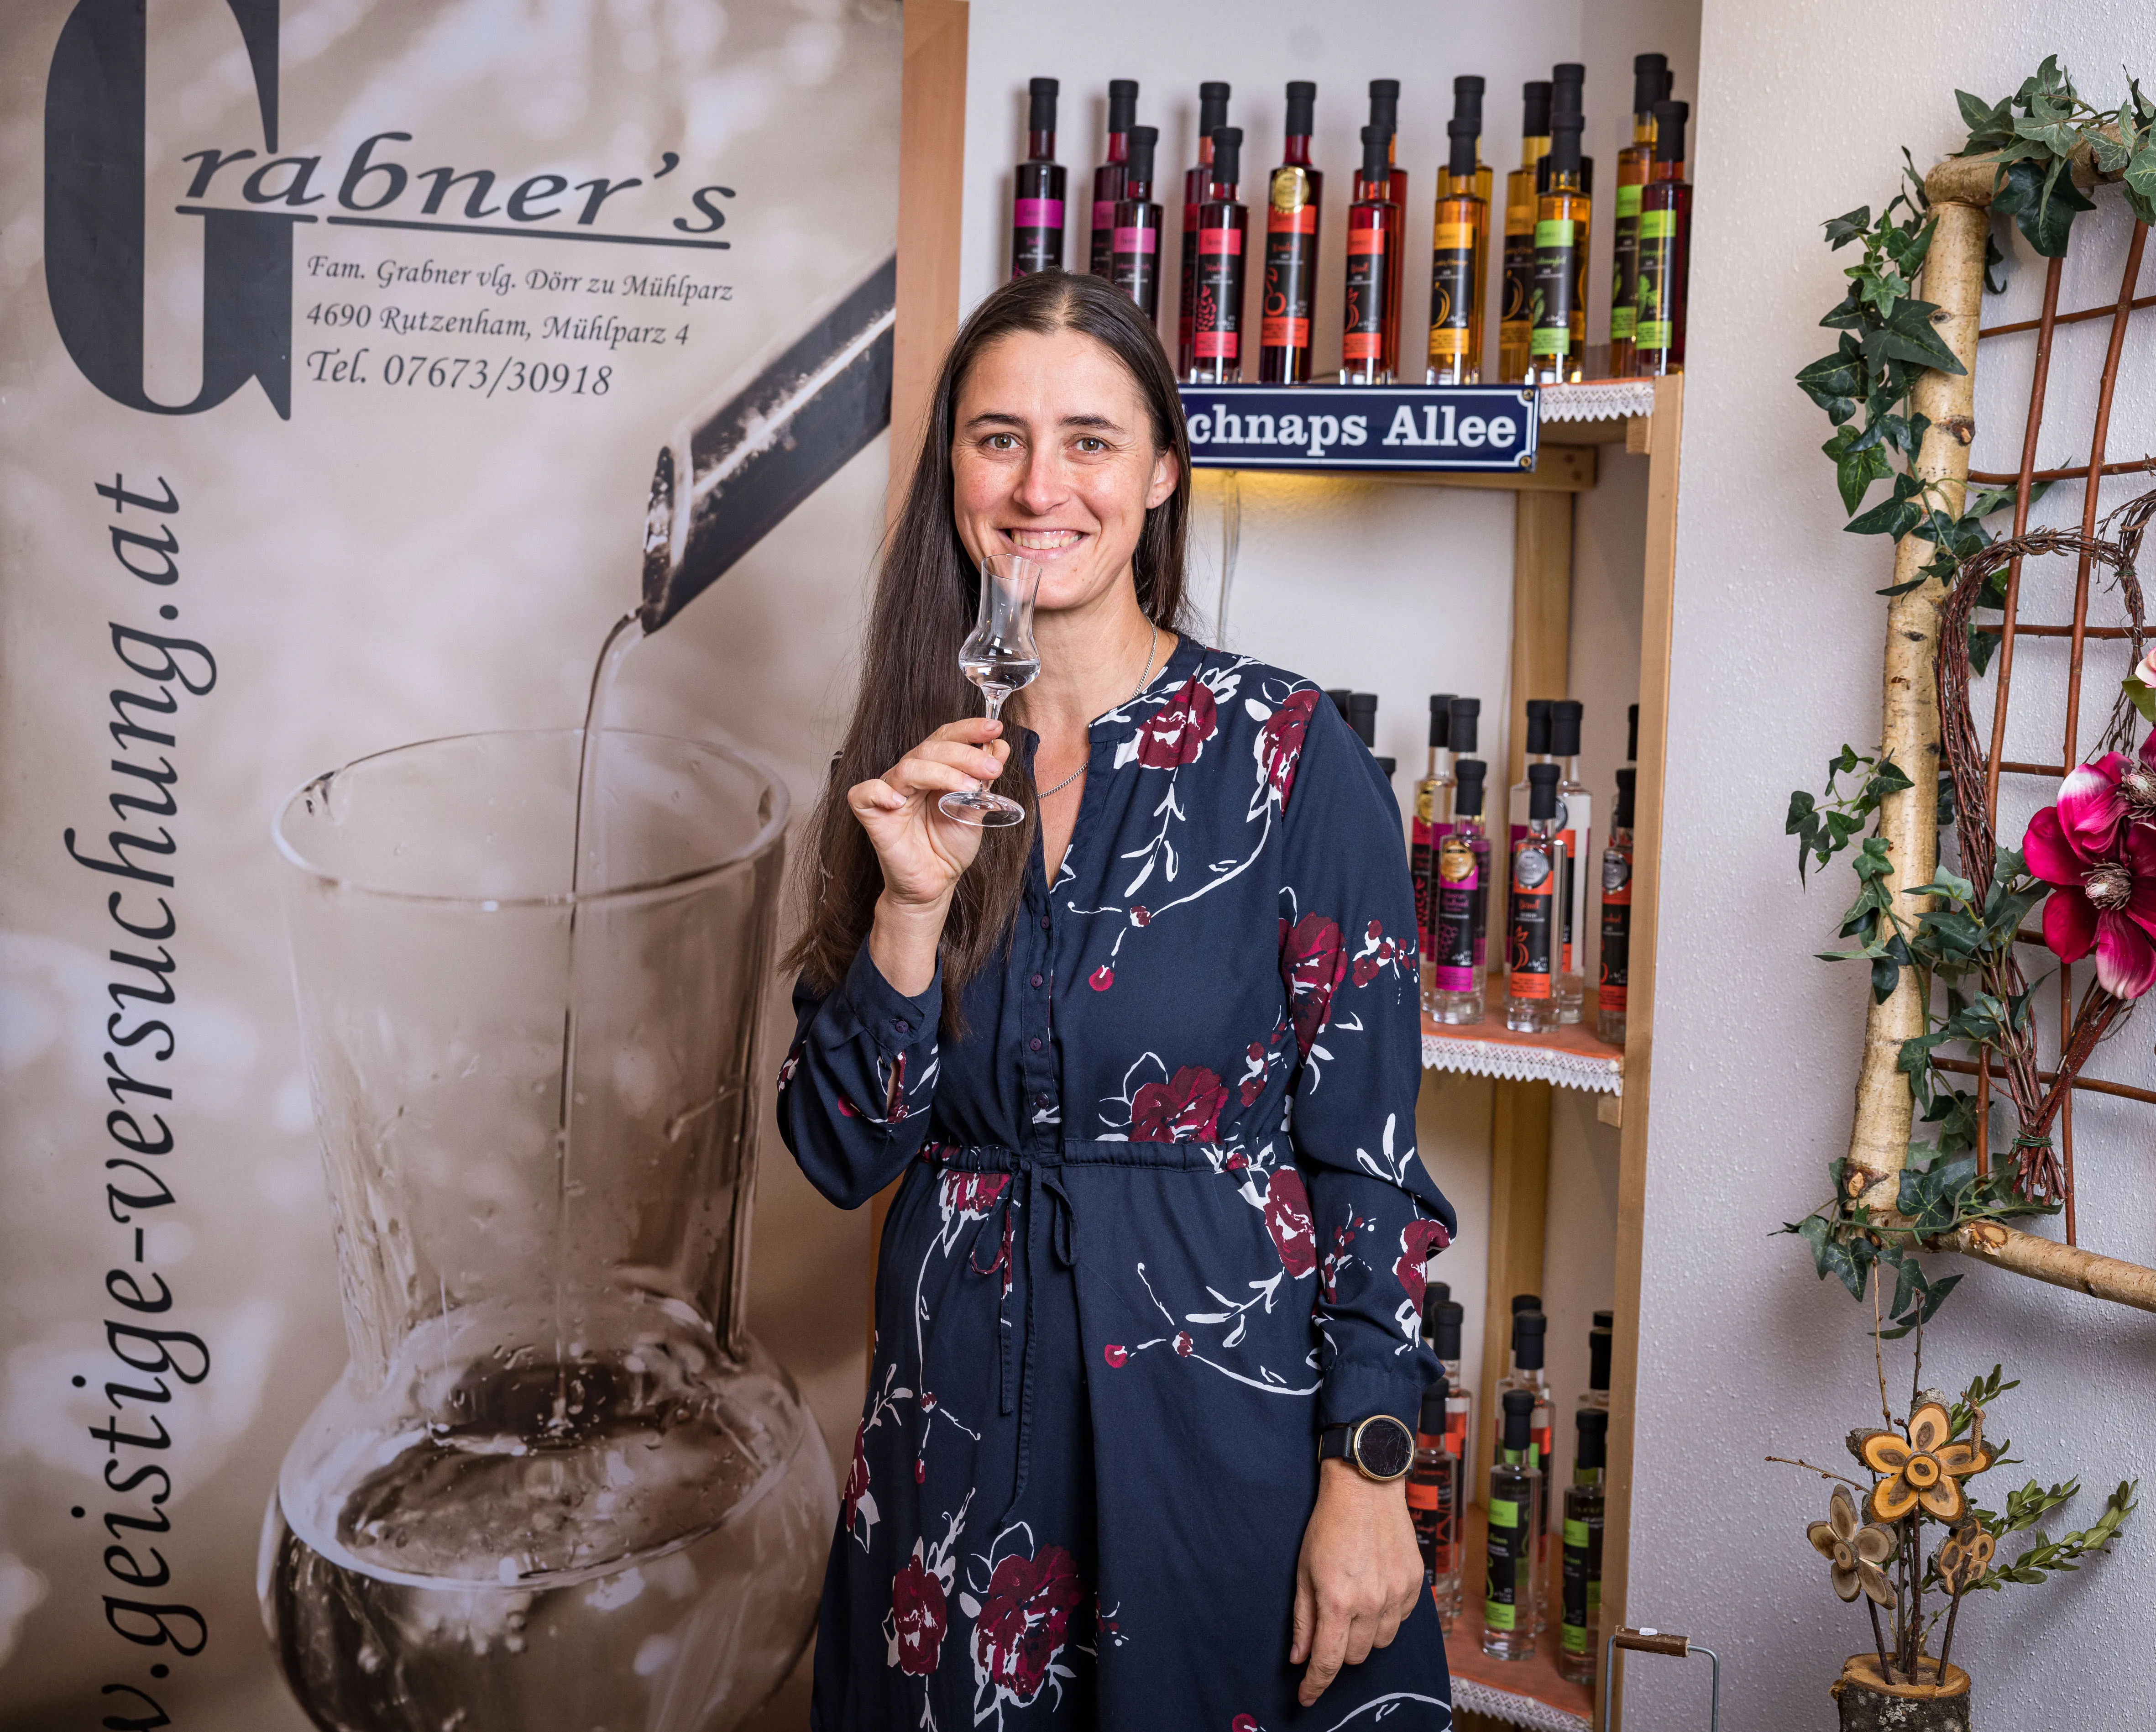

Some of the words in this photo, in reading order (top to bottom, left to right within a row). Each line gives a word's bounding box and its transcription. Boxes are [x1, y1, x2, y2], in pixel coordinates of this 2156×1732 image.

[306, 255, 365, 279] Fam.
[377, 259, 472, 289] Grabner
[476, 263, 516, 296] vlg.
[525, 268, 583, 293] Dörr
[586, 278, 615, 294] zu
[622, 274, 733, 306] Mühlparz
[306, 303, 372, 328] 4690
[379, 306, 531, 341] Rutzenham,
[542, 314, 666, 351] Mühlparz
[675, 324, 690, 346] 4
[306, 347, 371, 384] Tel.
[383, 354, 613, 399] 07673/30918
[1182, 404, 1368, 456] chnaps
[1382, 405, 1517, 447] Allee
